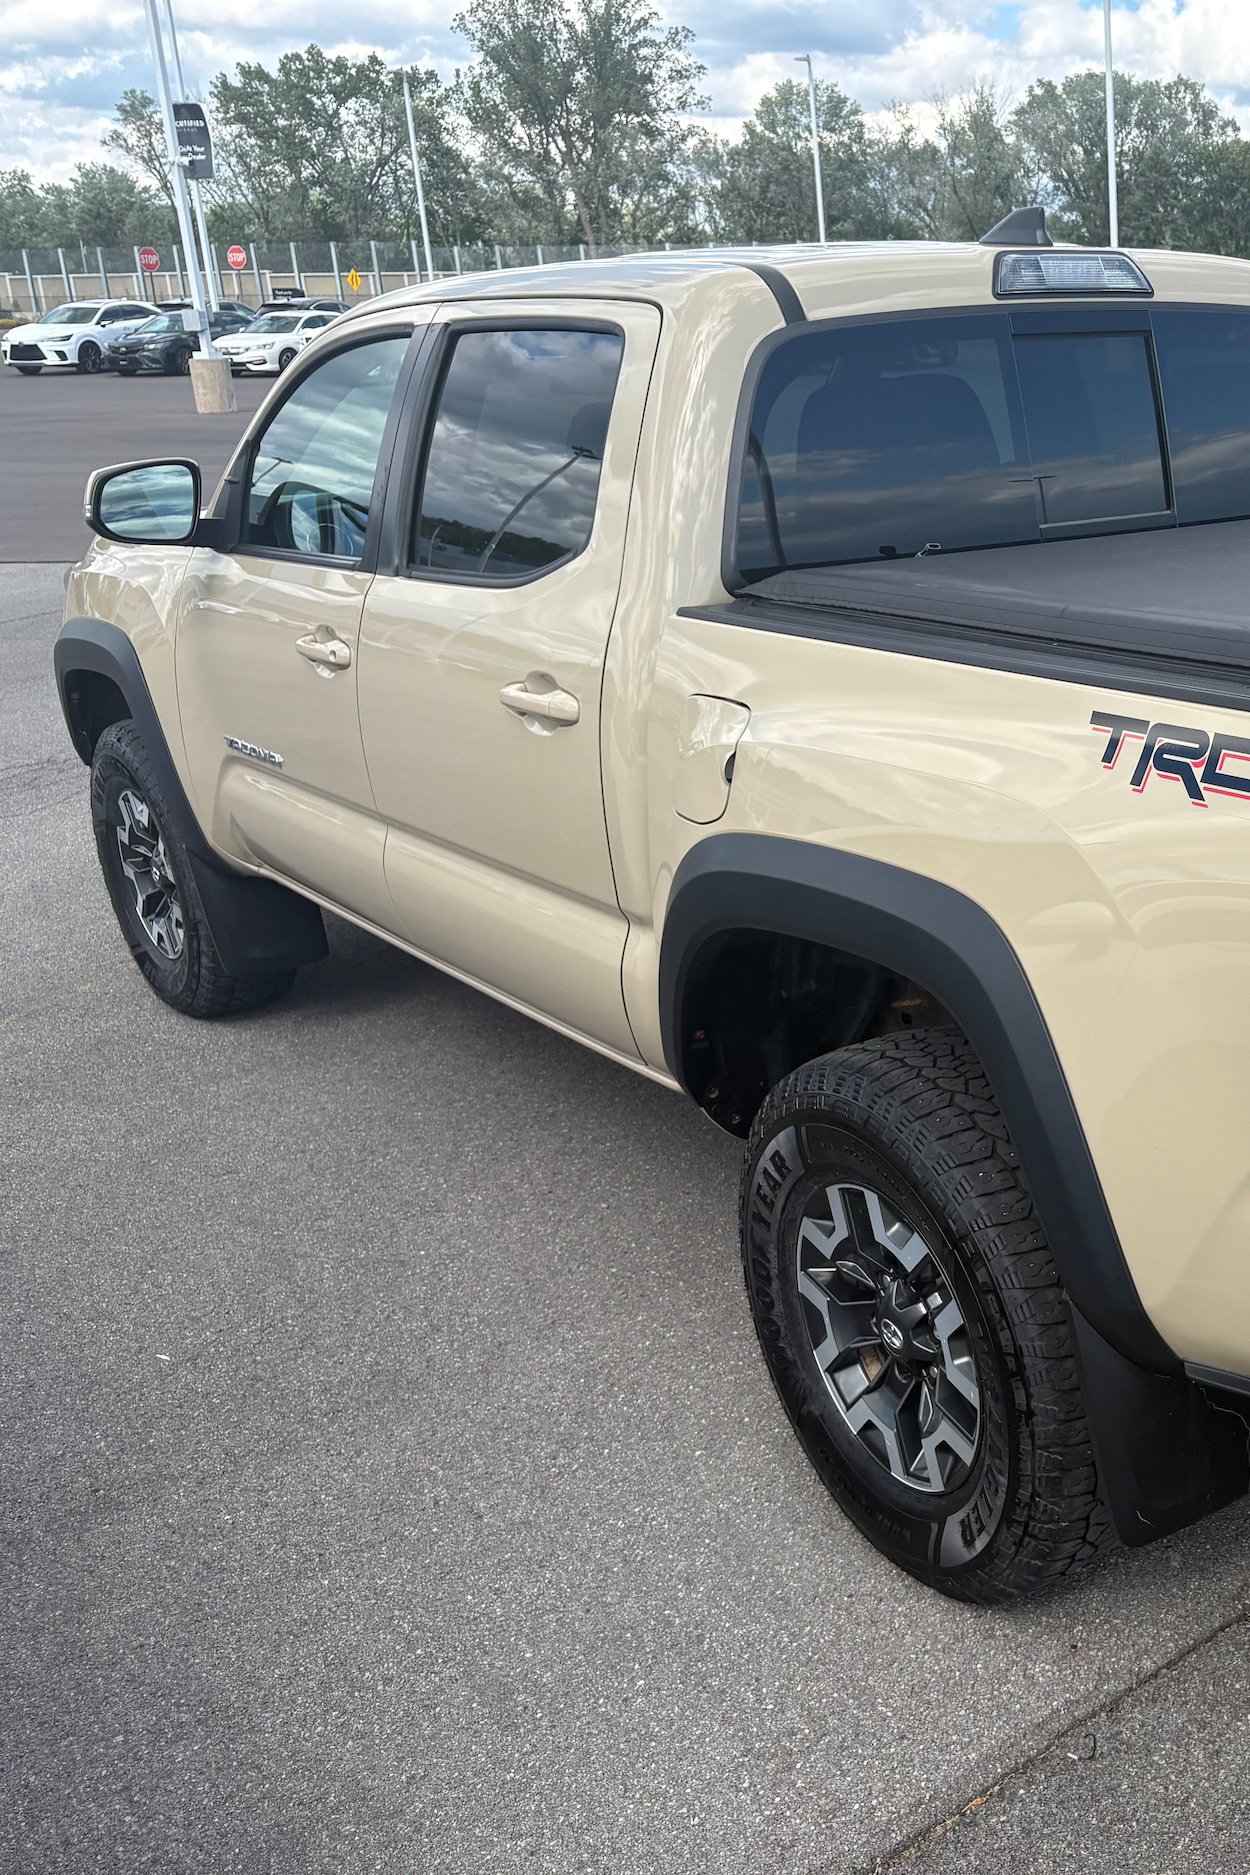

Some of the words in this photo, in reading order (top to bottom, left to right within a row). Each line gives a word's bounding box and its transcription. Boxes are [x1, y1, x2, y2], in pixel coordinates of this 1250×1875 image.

[140, 253, 158, 265] STOP
[229, 252, 245, 263] STOP
[224, 735, 284, 764] TACOMA
